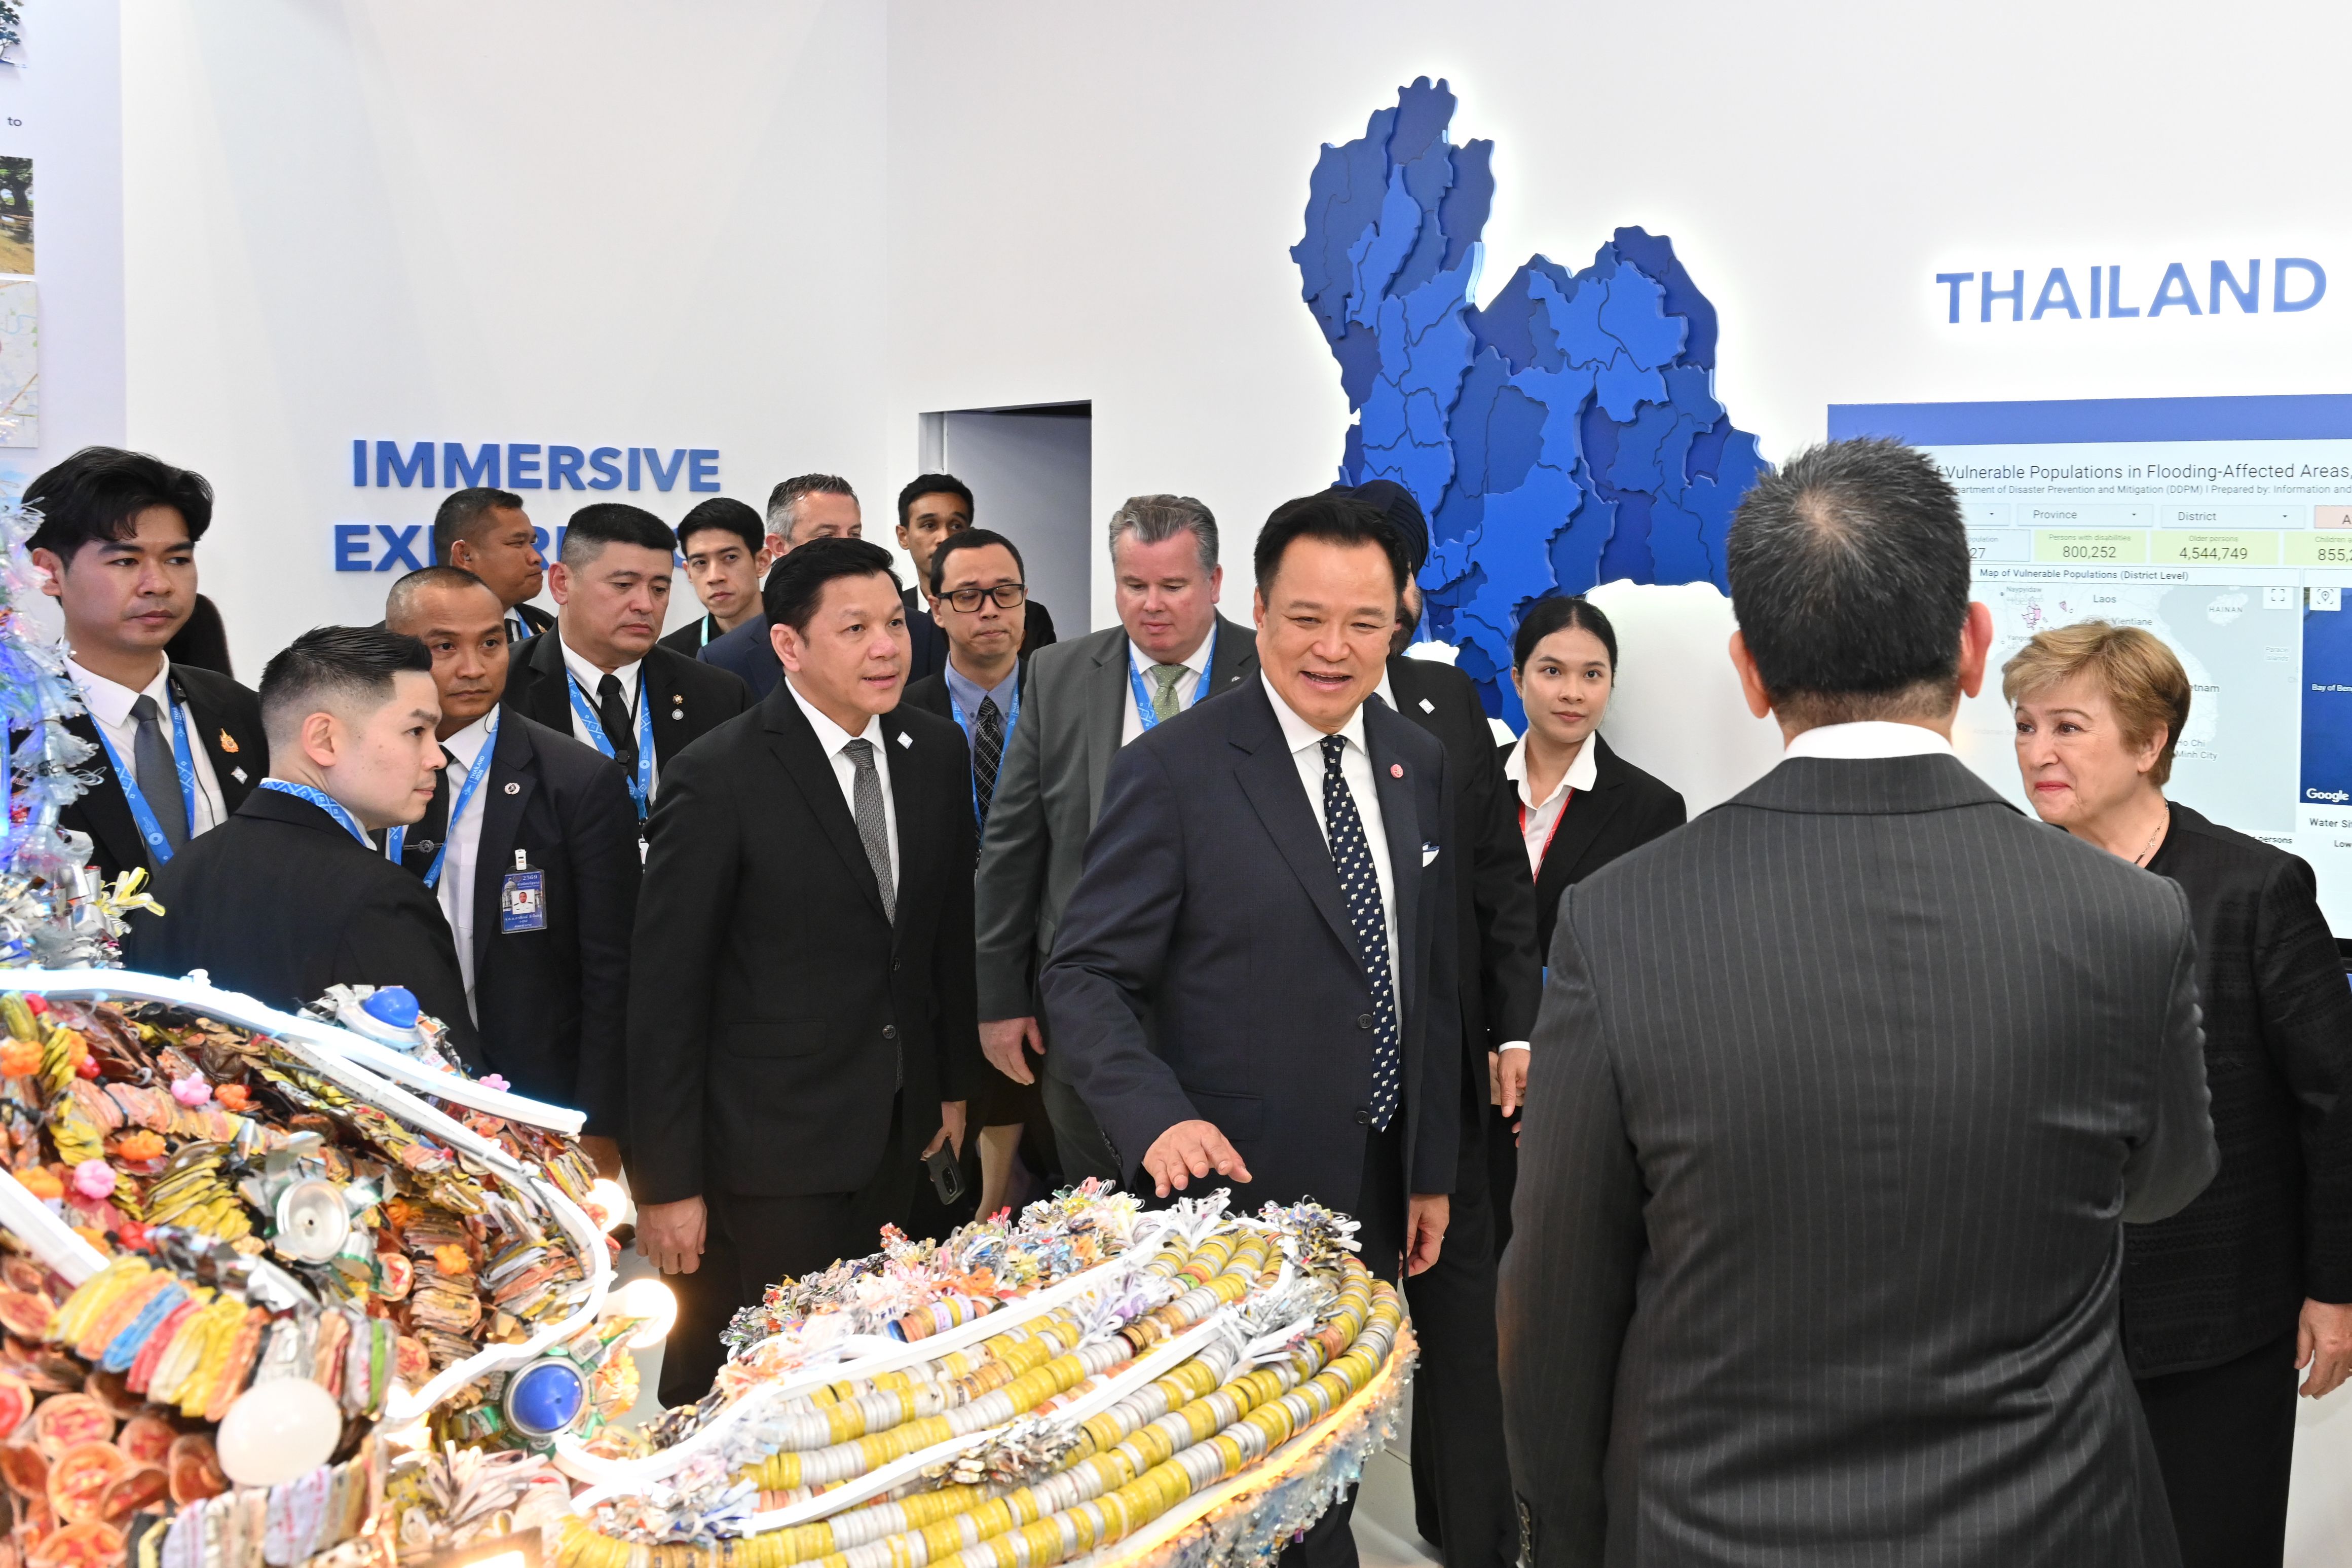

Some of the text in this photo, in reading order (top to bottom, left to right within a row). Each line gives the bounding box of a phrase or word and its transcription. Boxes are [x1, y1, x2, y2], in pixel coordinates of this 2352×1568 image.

[8, 117, 22, 126] to
[1936, 257, 2327, 323] THAILAND
[353, 439, 721, 492] IMMERSIVE
[1946, 465, 2025, 478] Vulnerable
[2030, 465, 2122, 481] Populations
[2128, 465, 2141, 478] in
[2147, 463, 2294, 481] Flooding-Affected
[2009, 486, 2044, 494] Disaster
[2048, 486, 2096, 494] Prevention
[2098, 485, 2114, 493] and
[2117, 485, 2163, 496] Mitigation
[2167, 484, 2203, 495] (DDPM)
[2211, 485, 2254, 495] Prepared
[2257, 485, 2270, 495] by:
[2274, 484, 2331, 493] Information
[2033, 510, 2077, 519] Province
[2178, 511, 2216, 521] District
[1969, 548, 1986, 559] 27
[2063, 546, 2117, 559] 800,252
[2179, 547, 2248, 561] 4,544,749
[1980, 569, 2189, 581] Map of Vulnerable Populations (District Level)
[2093, 594, 2116, 603] Laos
[2111, 617, 2152, 626] Vientiane
[2312, 684, 2327, 692] Bay
[2200, 751, 2217, 761] City
[470, 755, 485, 779] THAILAND
[474, 769, 484, 781] 2026
[2306, 788, 2349, 802] Google
[2309, 817, 2338, 827] Water
